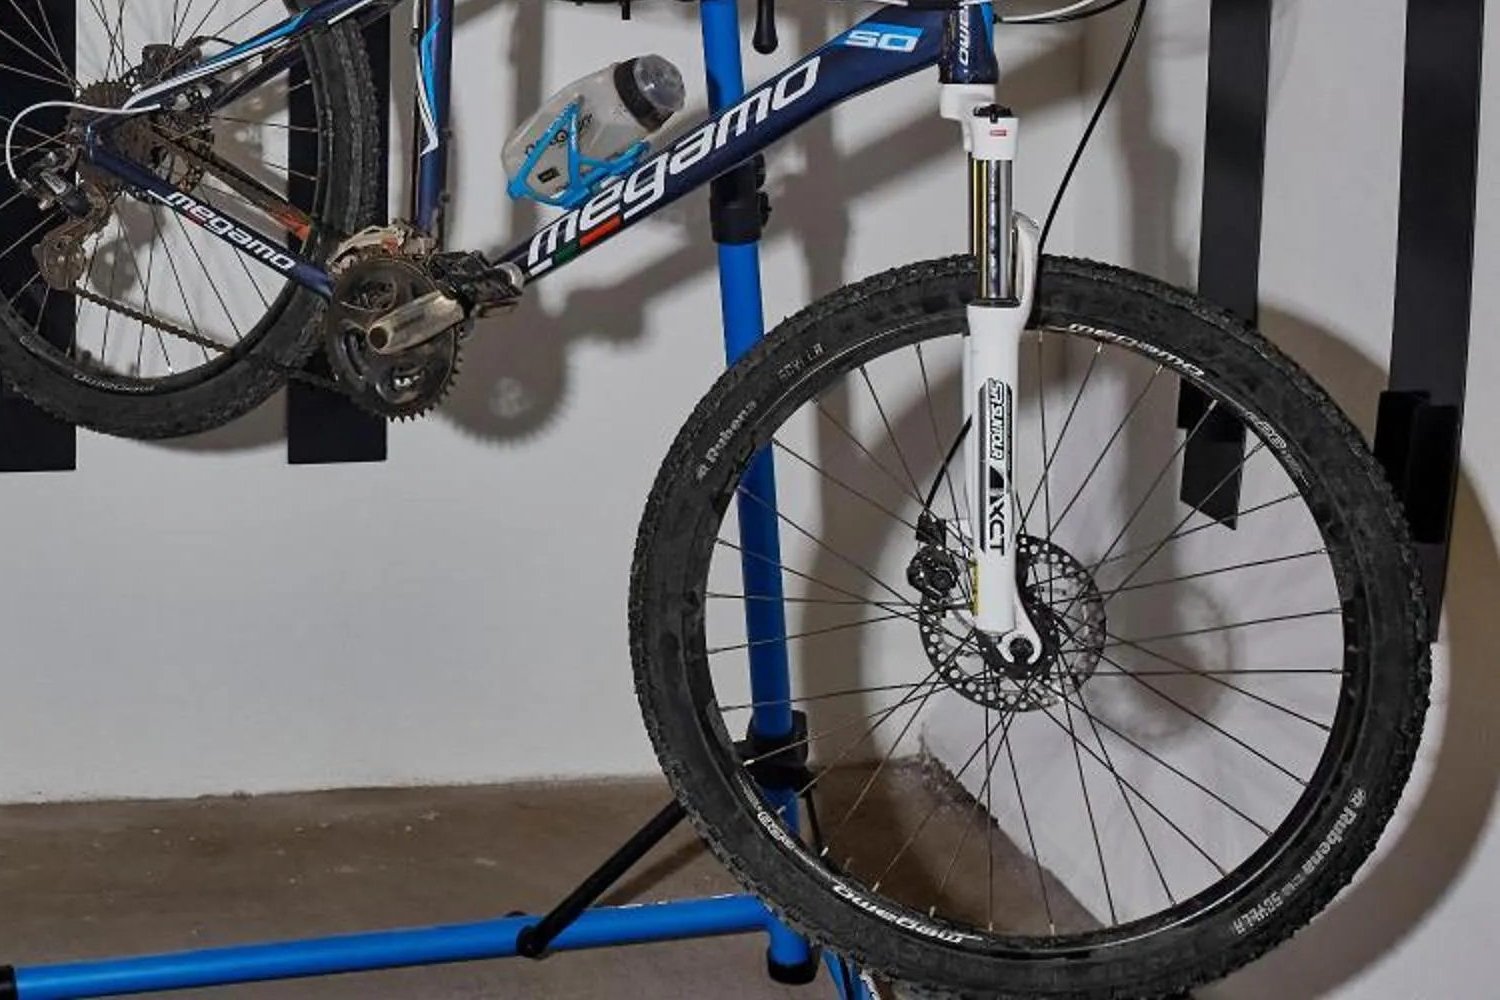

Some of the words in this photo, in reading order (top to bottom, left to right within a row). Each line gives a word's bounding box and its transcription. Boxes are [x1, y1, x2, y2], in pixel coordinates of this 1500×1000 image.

[526, 55, 821, 270] megamo
[165, 191, 297, 271] megamo
[989, 495, 1005, 556] XCT
[1301, 805, 1357, 875] Rubena
